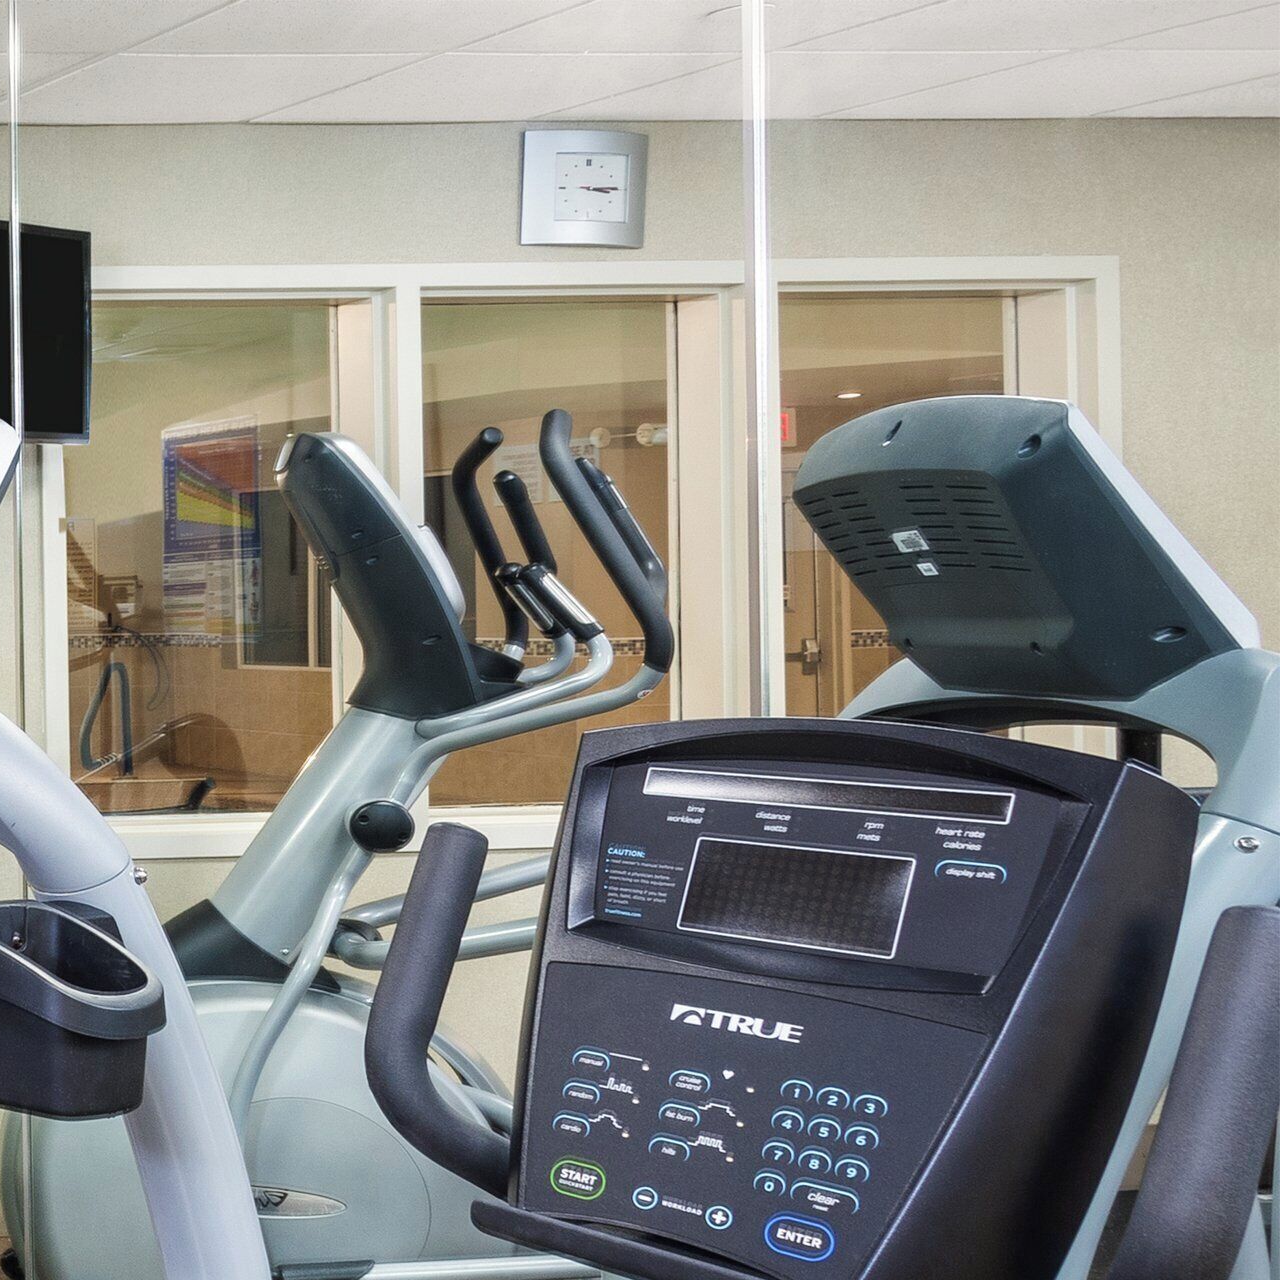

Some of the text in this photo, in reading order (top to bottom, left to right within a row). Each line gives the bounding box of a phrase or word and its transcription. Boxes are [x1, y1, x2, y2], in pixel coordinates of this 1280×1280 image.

[687, 805, 706, 814] time
[666, 815, 704, 825] worklevel
[755, 811, 791, 821] distance
[763, 825, 789, 833] watts
[863, 821, 886, 831] rpm
[855, 832, 882, 842] mets
[935, 826, 986, 840] heart rate
[941, 841, 983, 852] calories
[607, 847, 646, 858] CAUTION:
[945, 867, 997, 880] display shift
[706, 1008, 804, 1044] TRUE
[578, 1056, 605, 1068] manual
[678, 1074, 702, 1086] cruise
[674, 1081, 703, 1093] control
[567, 1089, 595, 1101] random
[793, 1088, 801, 1099] 1
[827, 1096, 838, 1106] 2
[864, 1103, 875, 1114] 3
[676, 1112, 694, 1123] burn
[559, 1122, 583, 1134] cardio
[781, 1119, 793, 1130] 4
[818, 1127, 830, 1138] 5
[855, 1135, 867, 1146] 6
[773, 1150, 784, 1161] 7
[809, 1158, 820, 1170] 8
[559, 1167, 598, 1186] START
[846, 1167, 858, 1178] 9
[763, 1181, 774, 1192] 0
[806, 1192, 841, 1207] clear
[661, 1201, 703, 1216] WORKLOAD
[776, 1227, 823, 1250] ENTER
